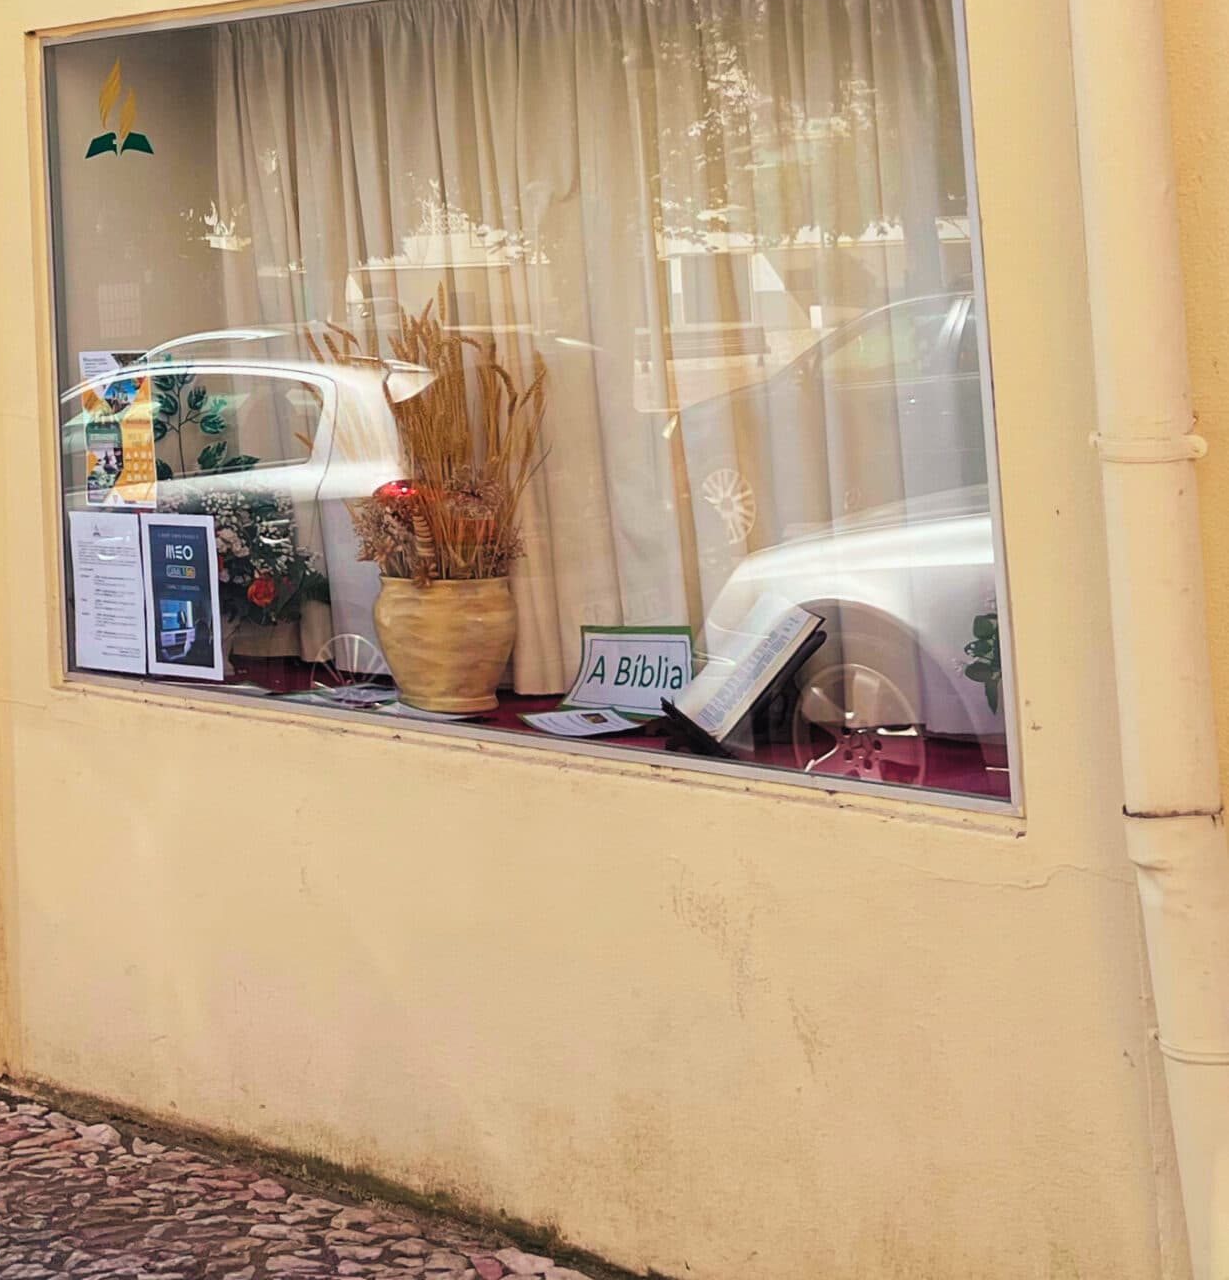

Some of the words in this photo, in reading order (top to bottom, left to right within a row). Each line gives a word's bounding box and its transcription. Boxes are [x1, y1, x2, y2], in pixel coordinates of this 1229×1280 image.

[165, 543, 194, 561] MEO
[586, 655, 606, 685] A
[613, 653, 683, 690] Bíblia
